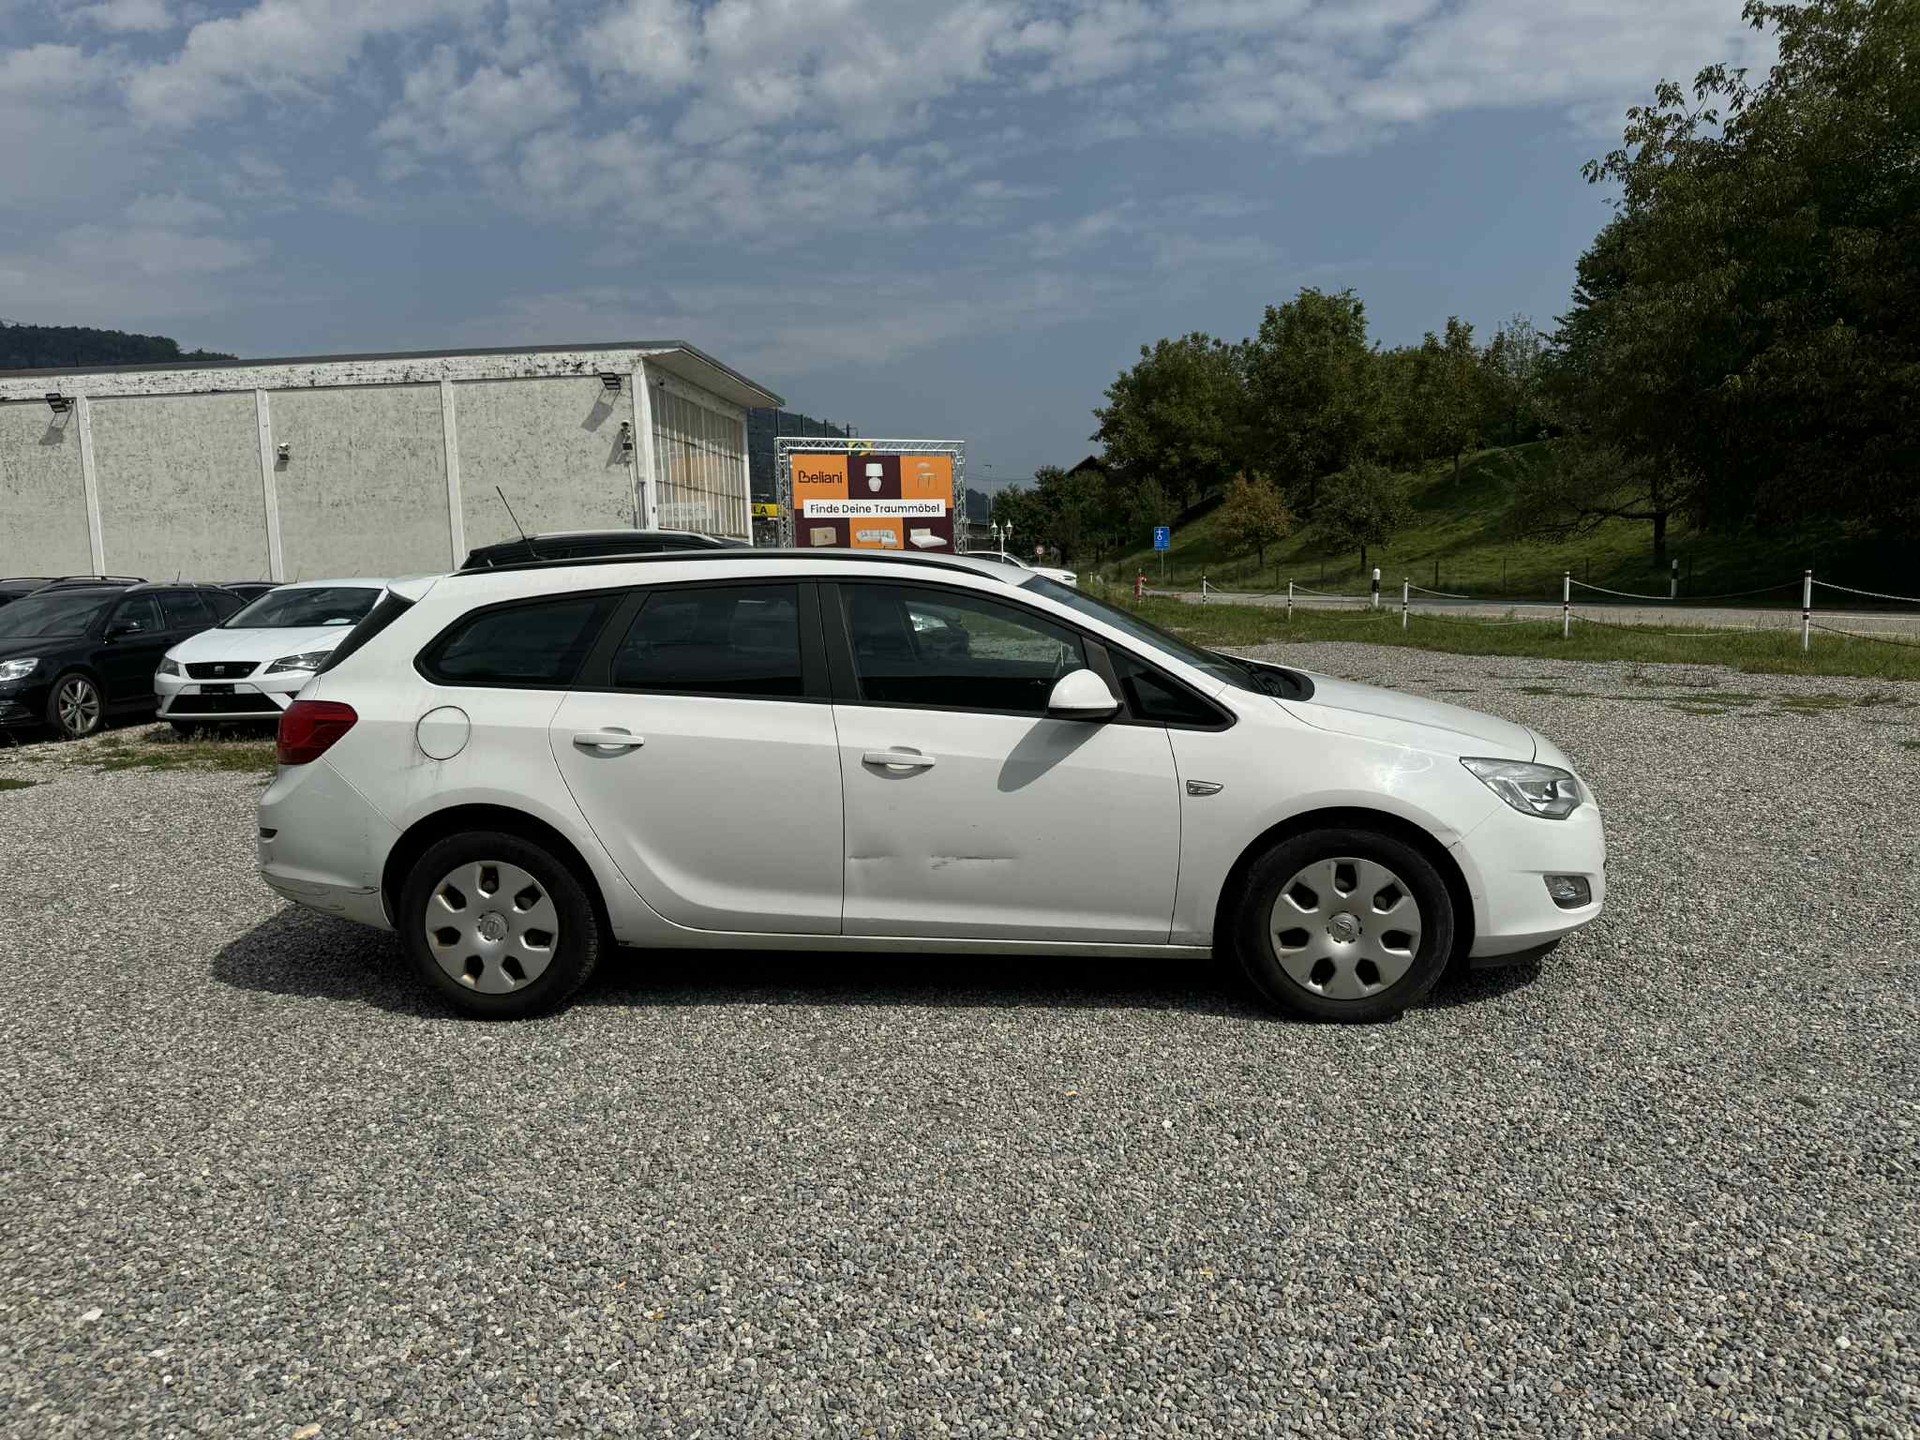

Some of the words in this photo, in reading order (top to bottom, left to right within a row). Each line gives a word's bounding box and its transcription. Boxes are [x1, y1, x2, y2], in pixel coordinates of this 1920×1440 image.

[798, 470, 843, 484] Beliani
[810, 504, 840, 514] Finde
[842, 504, 872, 514] Deine
[874, 503, 940, 513] Traummöbel
